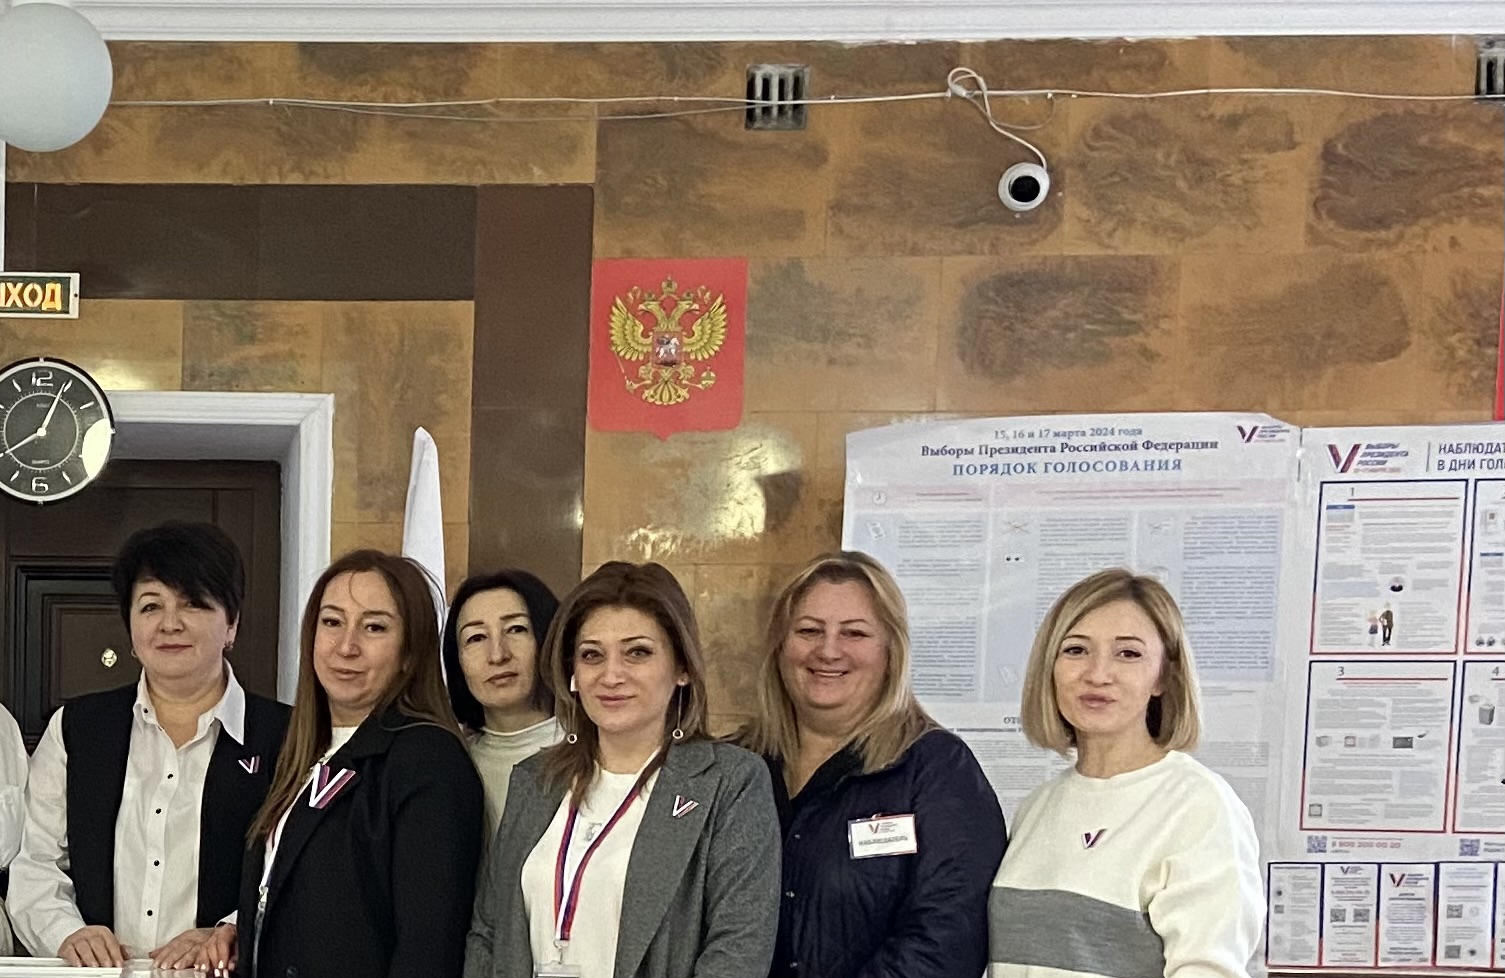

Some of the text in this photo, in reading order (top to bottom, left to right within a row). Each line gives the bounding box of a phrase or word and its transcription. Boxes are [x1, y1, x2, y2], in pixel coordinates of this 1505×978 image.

[31, 370, 54, 387] 12
[994, 427, 1143, 440] 15, 16 и 17 марта 2024 года
[921, 439, 1219, 459] Выборы Президента Российской Федерации
[952, 458, 1182, 476] ПОРЯДОК ГОЛОСОВАНИЯ
[1437, 458, 1505, 472] В ДНИ ГОЛ
[32, 476, 49, 493] 6
[1337, 666, 1345, 676] 3
[1492, 666, 1500, 676] 4
